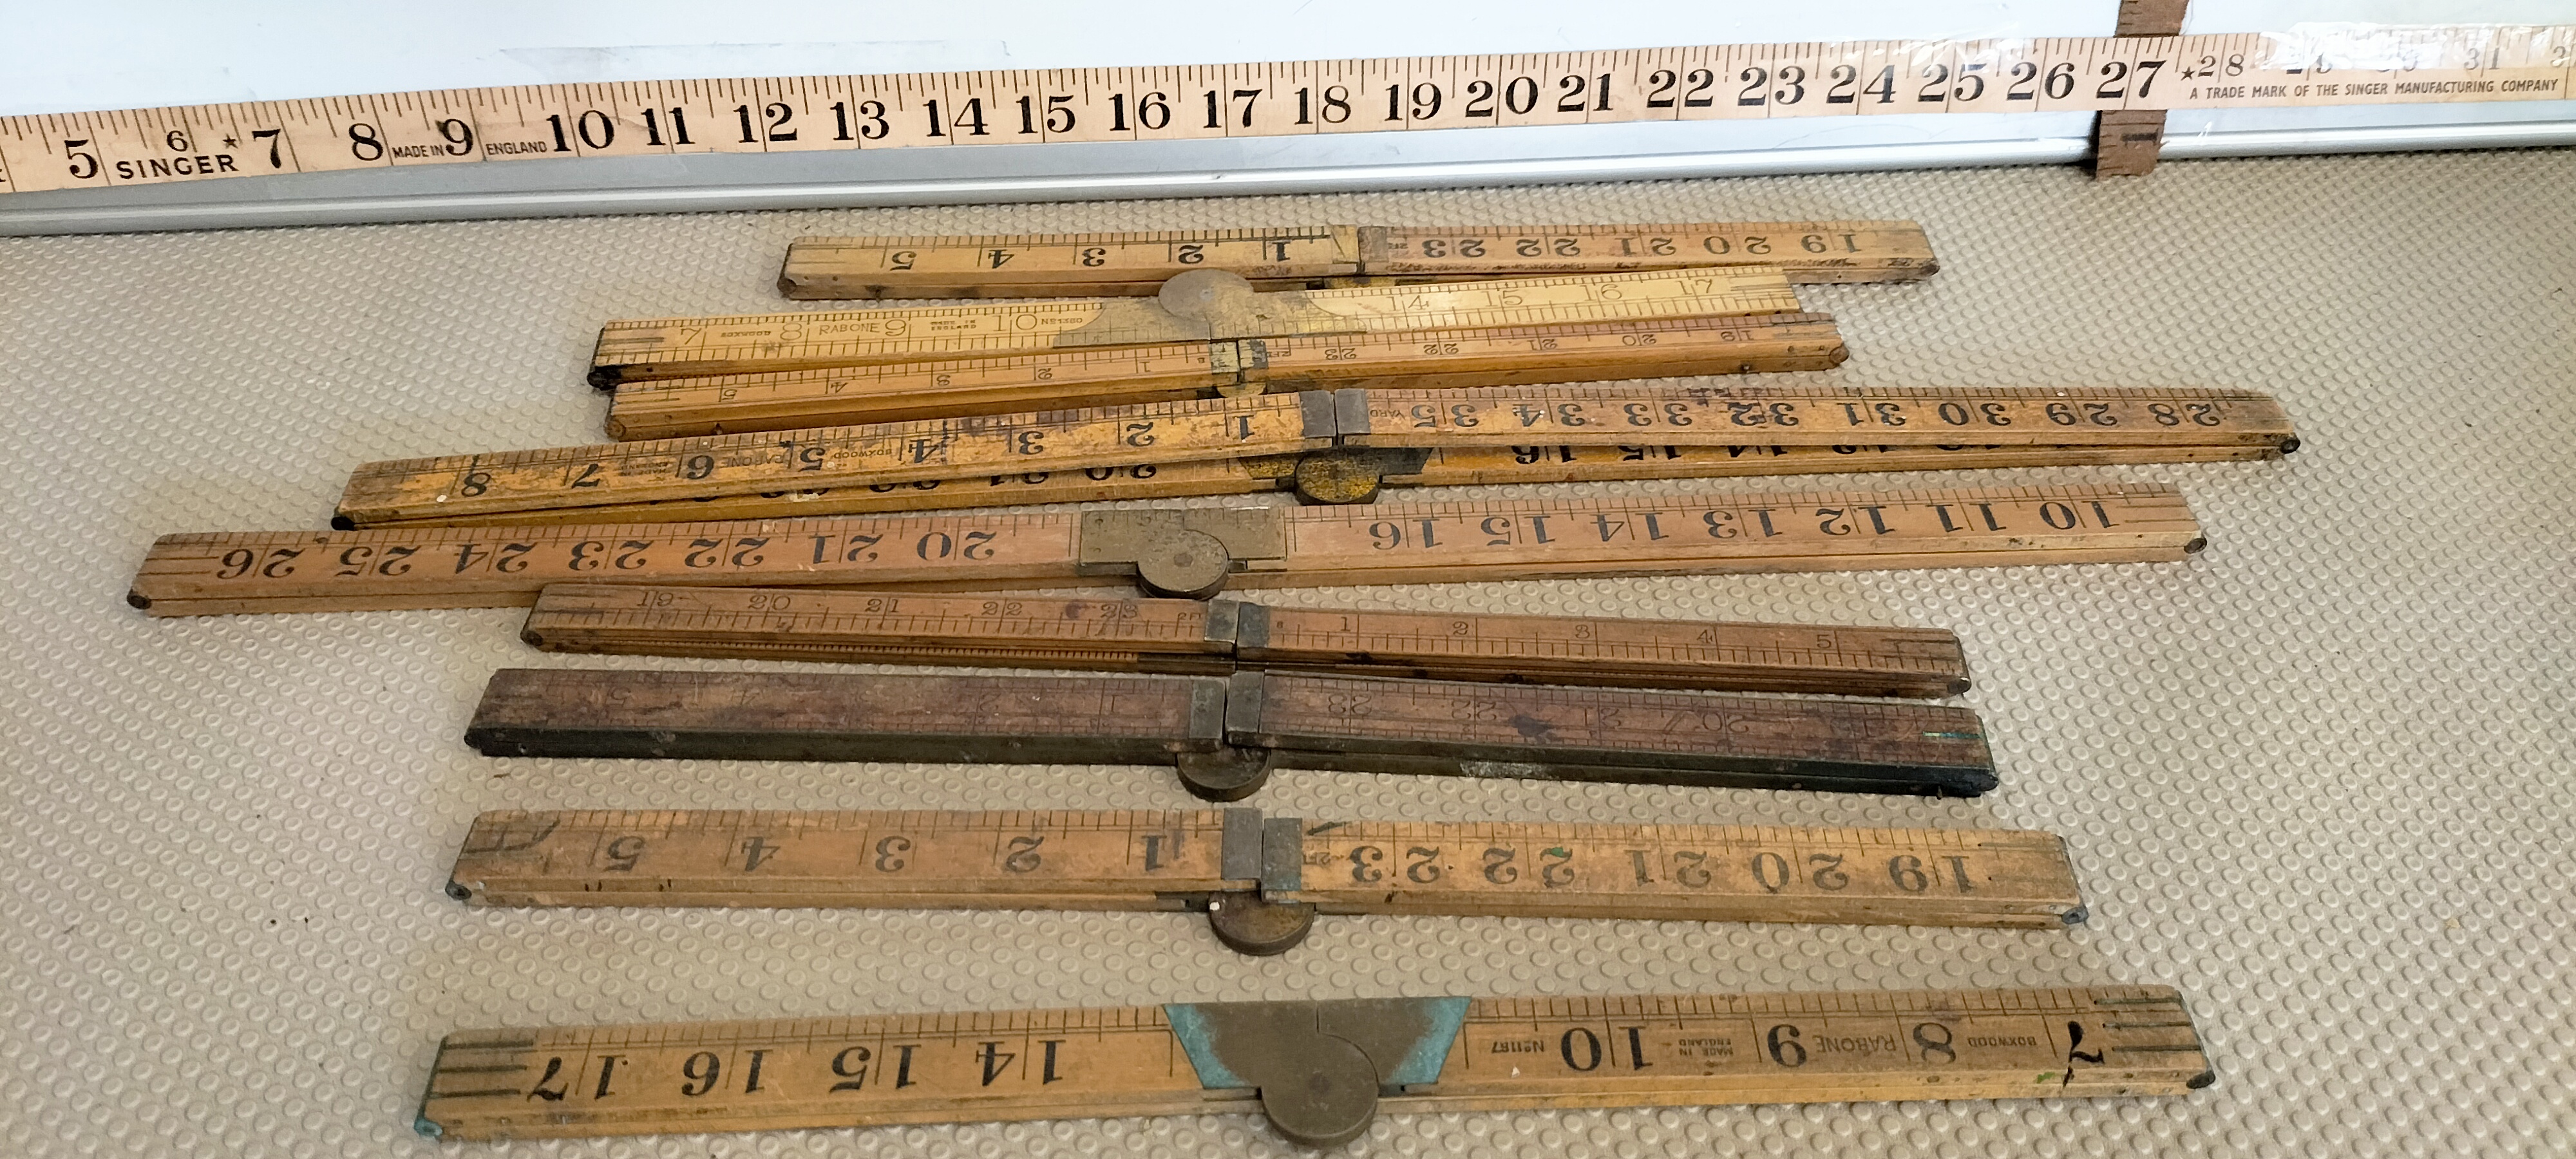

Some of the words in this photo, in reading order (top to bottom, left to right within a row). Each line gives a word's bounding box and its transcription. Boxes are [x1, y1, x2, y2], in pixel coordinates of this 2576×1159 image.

[2190, 87, 2199, 99] A
[2206, 86, 2245, 99] TRADE
[2252, 85, 2287, 99] MARK
[2295, 84, 2310, 97] OF
[2316, 83, 2339, 97] THE
[2345, 82, 2389, 97] SINGER
[2394, 79, 2494, 95] MANUFACTURING
[2501, 78, 2559, 93] COMPANY
[64, 139, 99, 179] 5
[166, 130, 188, 152] 6
[252, 129, 281, 169] 7
[348, 122, 384, 162] 8
[444, 118, 474, 157] 9
[547, 109, 615, 153] 10
[640, 106, 696, 146] 11
[734, 102, 798, 143] 12
[829, 100, 889, 141] 13
[923, 98, 989, 137] 14
[1015, 95, 1076, 134] 15
[1108, 91, 1171, 133] 16
[1202, 88, 1263, 129] 17
[1294, 84, 1352, 126] 18
[1385, 82, 1443, 122] 19
[1465, 76, 1539, 118] 20
[1557, 73, 1613, 113] 21
[1646, 67, 1714, 109] 22
[1737, 64, 1804, 107] 23
[1826, 64, 1897, 105] 24
[1917, 62, 1987, 103] 25
[2006, 61, 2076, 101] 26
[2096, 60, 2166, 99] 27
[2197, 53, 2244, 78] 28
[2463, 47, 2501, 71] 31
[393, 144, 427, 158] MADE
[430, 143, 444, 156] IN
[486, 142, 547, 156] ENGLAND
[117, 154, 238, 179] SINGER
[891, 250, 918, 271] 5
[988, 249, 1016, 269] 4
[1083, 247, 1107, 267] 3
[1178, 245, 1205, 265] 2
[1270, 242, 1293, 264] 1
[1423, 238, 1486, 259] 23
[1515, 236, 1582, 258] 22
[1617, 236, 1677, 258] 21
[1703, 234, 1772, 256] 20
[1801, 233, 1862, 254] 19
[681, 328, 701, 344] 7
[780, 323, 802, 341] 8
[885, 319, 906, 337] 9
[994, 314, 1037, 332] 10
[1387, 295, 1430, 312] 14
[1485, 289, 1524, 308] 15
[1580, 284, 1622, 301] 16
[1675, 279, 1714, 296] 17
[819, 322, 880, 335] RABONE
[1325, 348, 1356, 360] 23
[1424, 344, 1459, 354] 22
[1531, 339, 1557, 351] 21
[1622, 334, 1656, 345] 20
[1721, 330, 1754, 341] 19
[722, 389, 737, 400] 5
[831, 382, 848, 393] 4
[937, 374, 951, 386] 3
[1038, 368, 1053, 380] 2
[1140, 361, 1150, 372] 1
[1370, 409, 1404, 418] YARD
[1412, 404, 1479, 428] 35
[1513, 402, 1585, 426] 34
[1624, 402, 1692, 426] 33
[1728, 402, 1799, 426] 32
[1837, 402, 1906, 426] 31
[1938, 402, 2011, 426] 30
[2045, 402, 2117, 426] 29
[2148, 402, 2221, 426] 28
[461, 472, 492, 496] 8
[571, 464, 600, 487] 7
[687, 455, 714, 480] 6
[800, 447, 825, 472] 5
[908, 438, 939, 464] 4
[1018, 431, 1044, 455] 3
[1126, 422, 1154, 447] 2
[1232, 415, 1256, 440] 1
[1368, 518, 1443, 549] 16
[1481, 515, 1555, 546] 15
[1590, 512, 1669, 542] 14
[1703, 509, 1783, 539] 13
[1815, 506, 1895, 536] 12
[1926, 503, 2006, 532] 11
[2039, 500, 2119, 531] 10
[216, 548, 305, 580] 26
[336, 545, 421, 578] 25
[454, 542, 538, 574] 24
[568, 540, 655, 572] 23
[684, 538, 770, 568] 22
[809, 534, 884, 565] 21
[916, 531, 997, 562] 20
[638, 592, 674, 607] 19
[748, 596, 791, 611] 20
[866, 599, 900, 613] 21
[982, 601, 1023, 616] 22
[1100, 603, 1138, 619] 23
[1341, 617, 1351, 632] 1
[1452, 621, 1469, 635] 2
[1575, 625, 1591, 639] 3
[1696, 630, 1713, 643] 4
[1816, 634, 1832, 648] 5
[603, 836, 645, 872] 5
[741, 837, 779, 872] 4
[875, 835, 910, 872] 3
[1006, 836, 1043, 872] 2
[1143, 834, 1166, 871] 1
[1350, 845, 1440, 884] 23
[1482, 847, 1576, 887] 22
[1623, 847, 1712, 887] 21
[1751, 852, 1849, 891] 20
[1889, 854, 1975, 893] 19
[1678, 1048, 1693, 1056] IN
[1812, 1033, 1897, 1054] RABONE
[1968, 1036, 2037, 1048] BOXWOOD
[527, 1055, 626, 1102] 17
[681, 1048, 773, 1096] 16
[829, 1044, 922, 1091] 15
[975, 1039, 1066, 1086] 14
[1560, 1025, 1653, 1071] 10
[1766, 1024, 1806, 1068] 9
[1913, 1022, 1956, 1063] 8
[2066, 1021, 2105, 1064] 7
